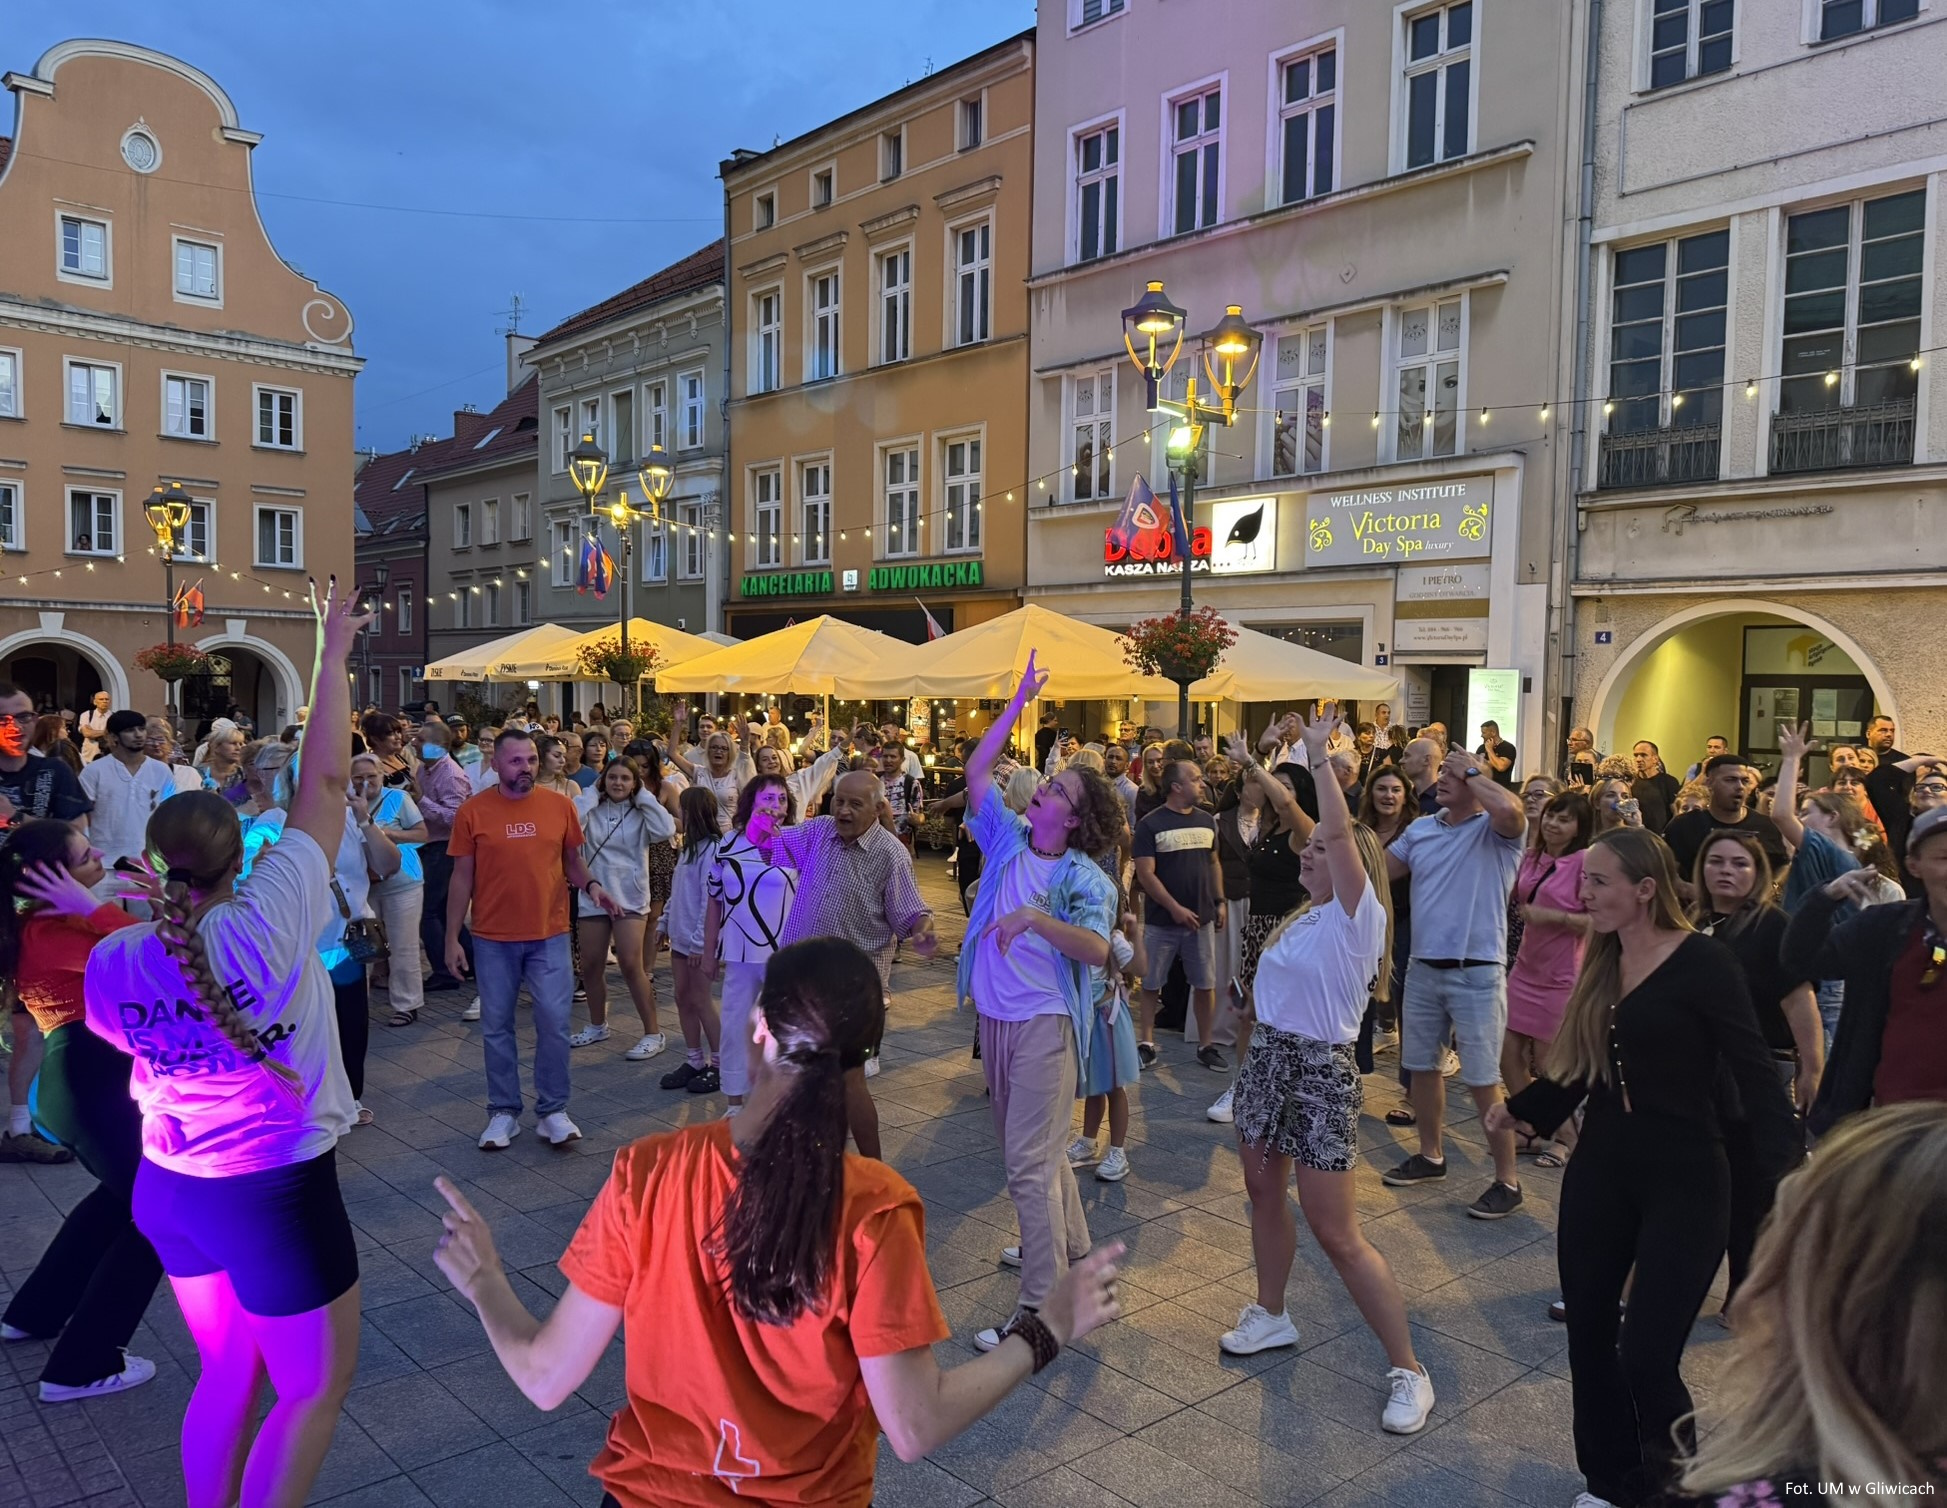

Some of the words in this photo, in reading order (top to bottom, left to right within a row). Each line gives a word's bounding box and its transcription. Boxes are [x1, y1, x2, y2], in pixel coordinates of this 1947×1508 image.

[1330, 491, 1392, 508] WELLNESS
[1398, 483, 1466, 502] INSTITUTE
[1349, 509, 1442, 541] Victoria
[1363, 538, 1391, 560] Day
[1396, 535, 1423, 558] Spa
[1425, 540, 1455, 553] luxury
[740, 571, 833, 596] KANCELARIA
[868, 561, 982, 590] ADWOKACKA
[1104, 562, 1153, 576] KASZA
[1599, 632, 1607, 642] 4
[1379, 656, 1384, 664] 3
[506, 822, 536, 836] LDS
[117, 978, 258, 1030] DANE
